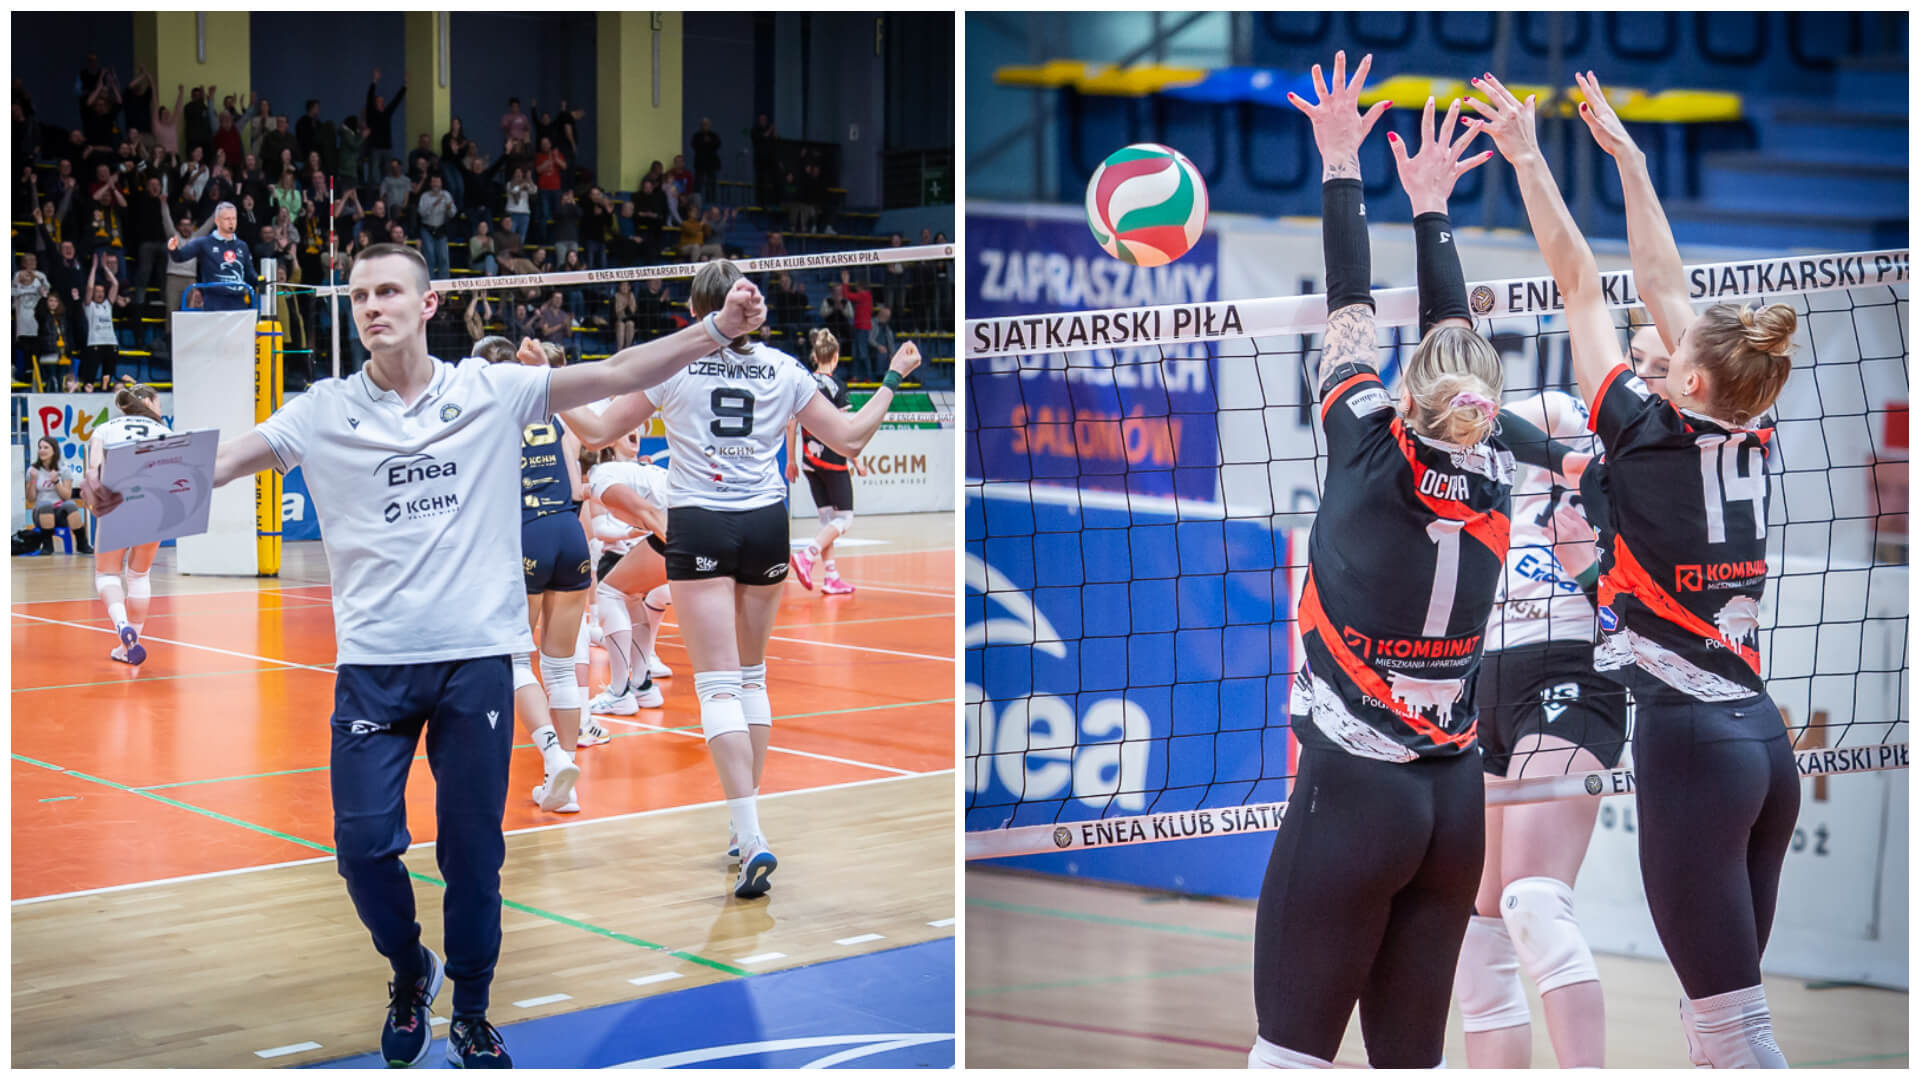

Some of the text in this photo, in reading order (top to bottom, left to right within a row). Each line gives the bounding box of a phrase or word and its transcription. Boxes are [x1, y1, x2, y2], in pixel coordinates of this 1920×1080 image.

[636, 266, 678, 278] SIATKARSKI
[760, 251, 879, 270] ENEA KLUB SIATKARSKI PIŁA
[979, 249, 1214, 308] ZAPRASZAMY
[1508, 280, 1565, 312] ENE
[1601, 274, 1644, 305] KL
[1690, 255, 1865, 298] SIATKARSKI
[973, 304, 1244, 353] SIATKARSKI PIŁA
[710, 386, 755, 437] 9
[521, 423, 558, 448] 0
[720, 447, 755, 456] KGHM
[863, 454, 927, 474] KGHM
[388, 461, 457, 487] Enea
[1695, 433, 1767, 544] 14
[406, 493, 458, 514] KGHM
[1422, 518, 1466, 638] 1
[1376, 634, 1481, 658] KOMBINAT
[1375, 657, 1425, 669] MIESZKANIA
[1880, 745, 1909, 768] PIŁ
[1081, 804, 1286, 846] ENEA KLUB SIATK
